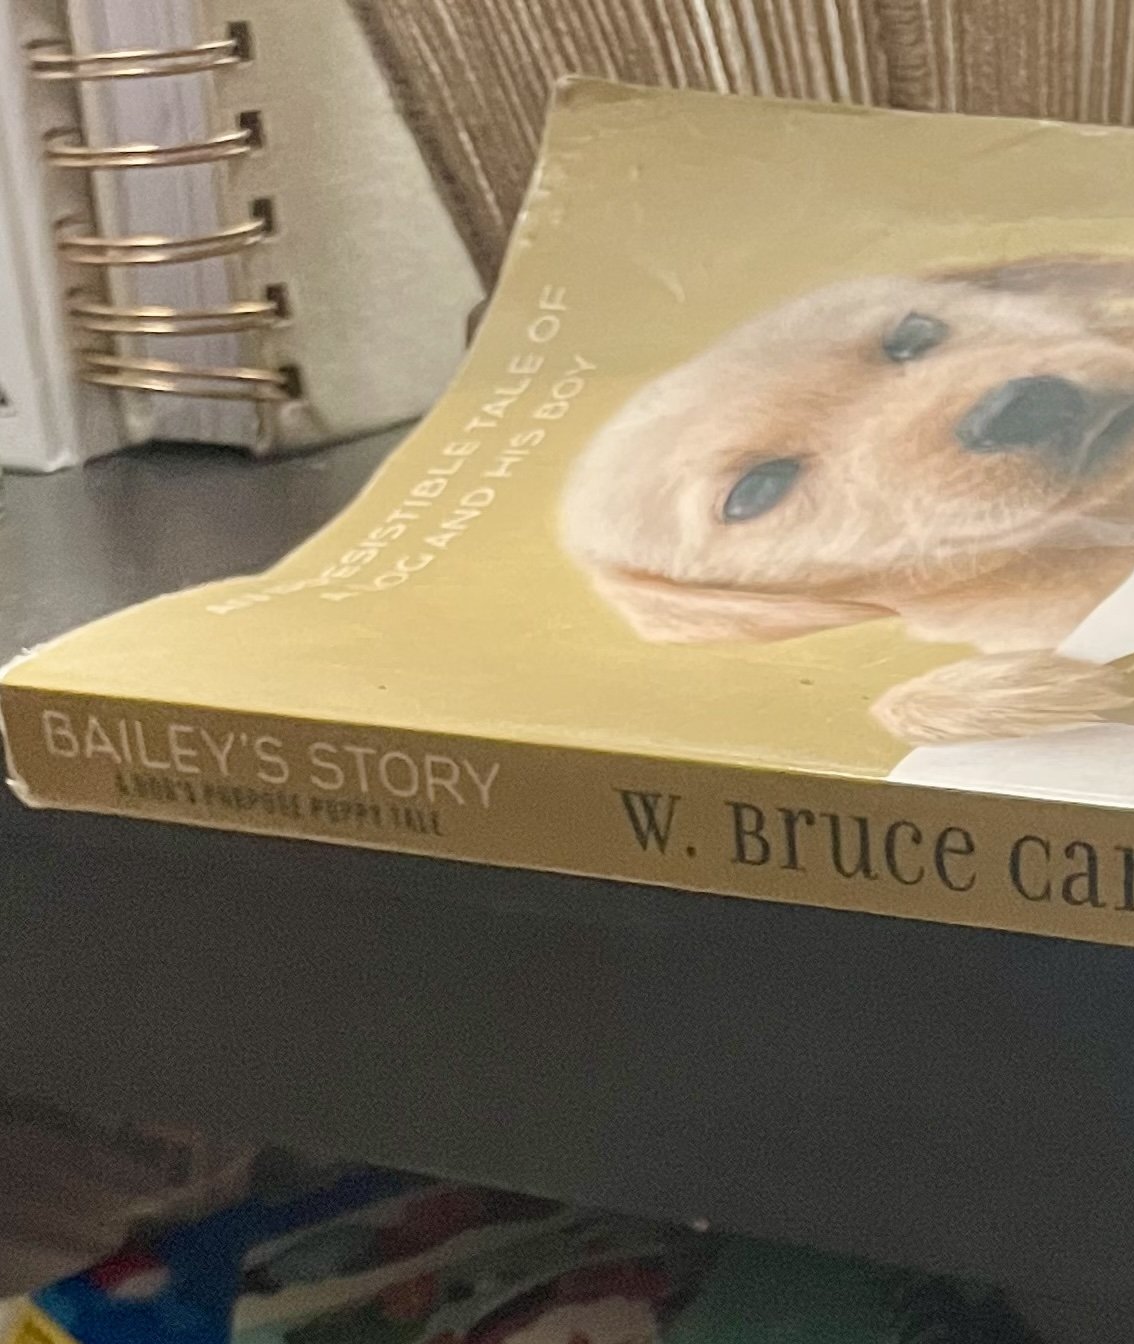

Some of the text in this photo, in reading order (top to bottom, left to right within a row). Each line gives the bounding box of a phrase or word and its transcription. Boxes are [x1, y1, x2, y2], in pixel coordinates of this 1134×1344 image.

[467, 355, 543, 430] TALE
[528, 285, 566, 342] OF
[423, 487, 494, 549] AND
[484, 429, 545, 478] HIS
[534, 354, 597, 420] BOY
[41, 708, 500, 808] BAILEY'S STORY
[613, 786, 698, 858] W.
